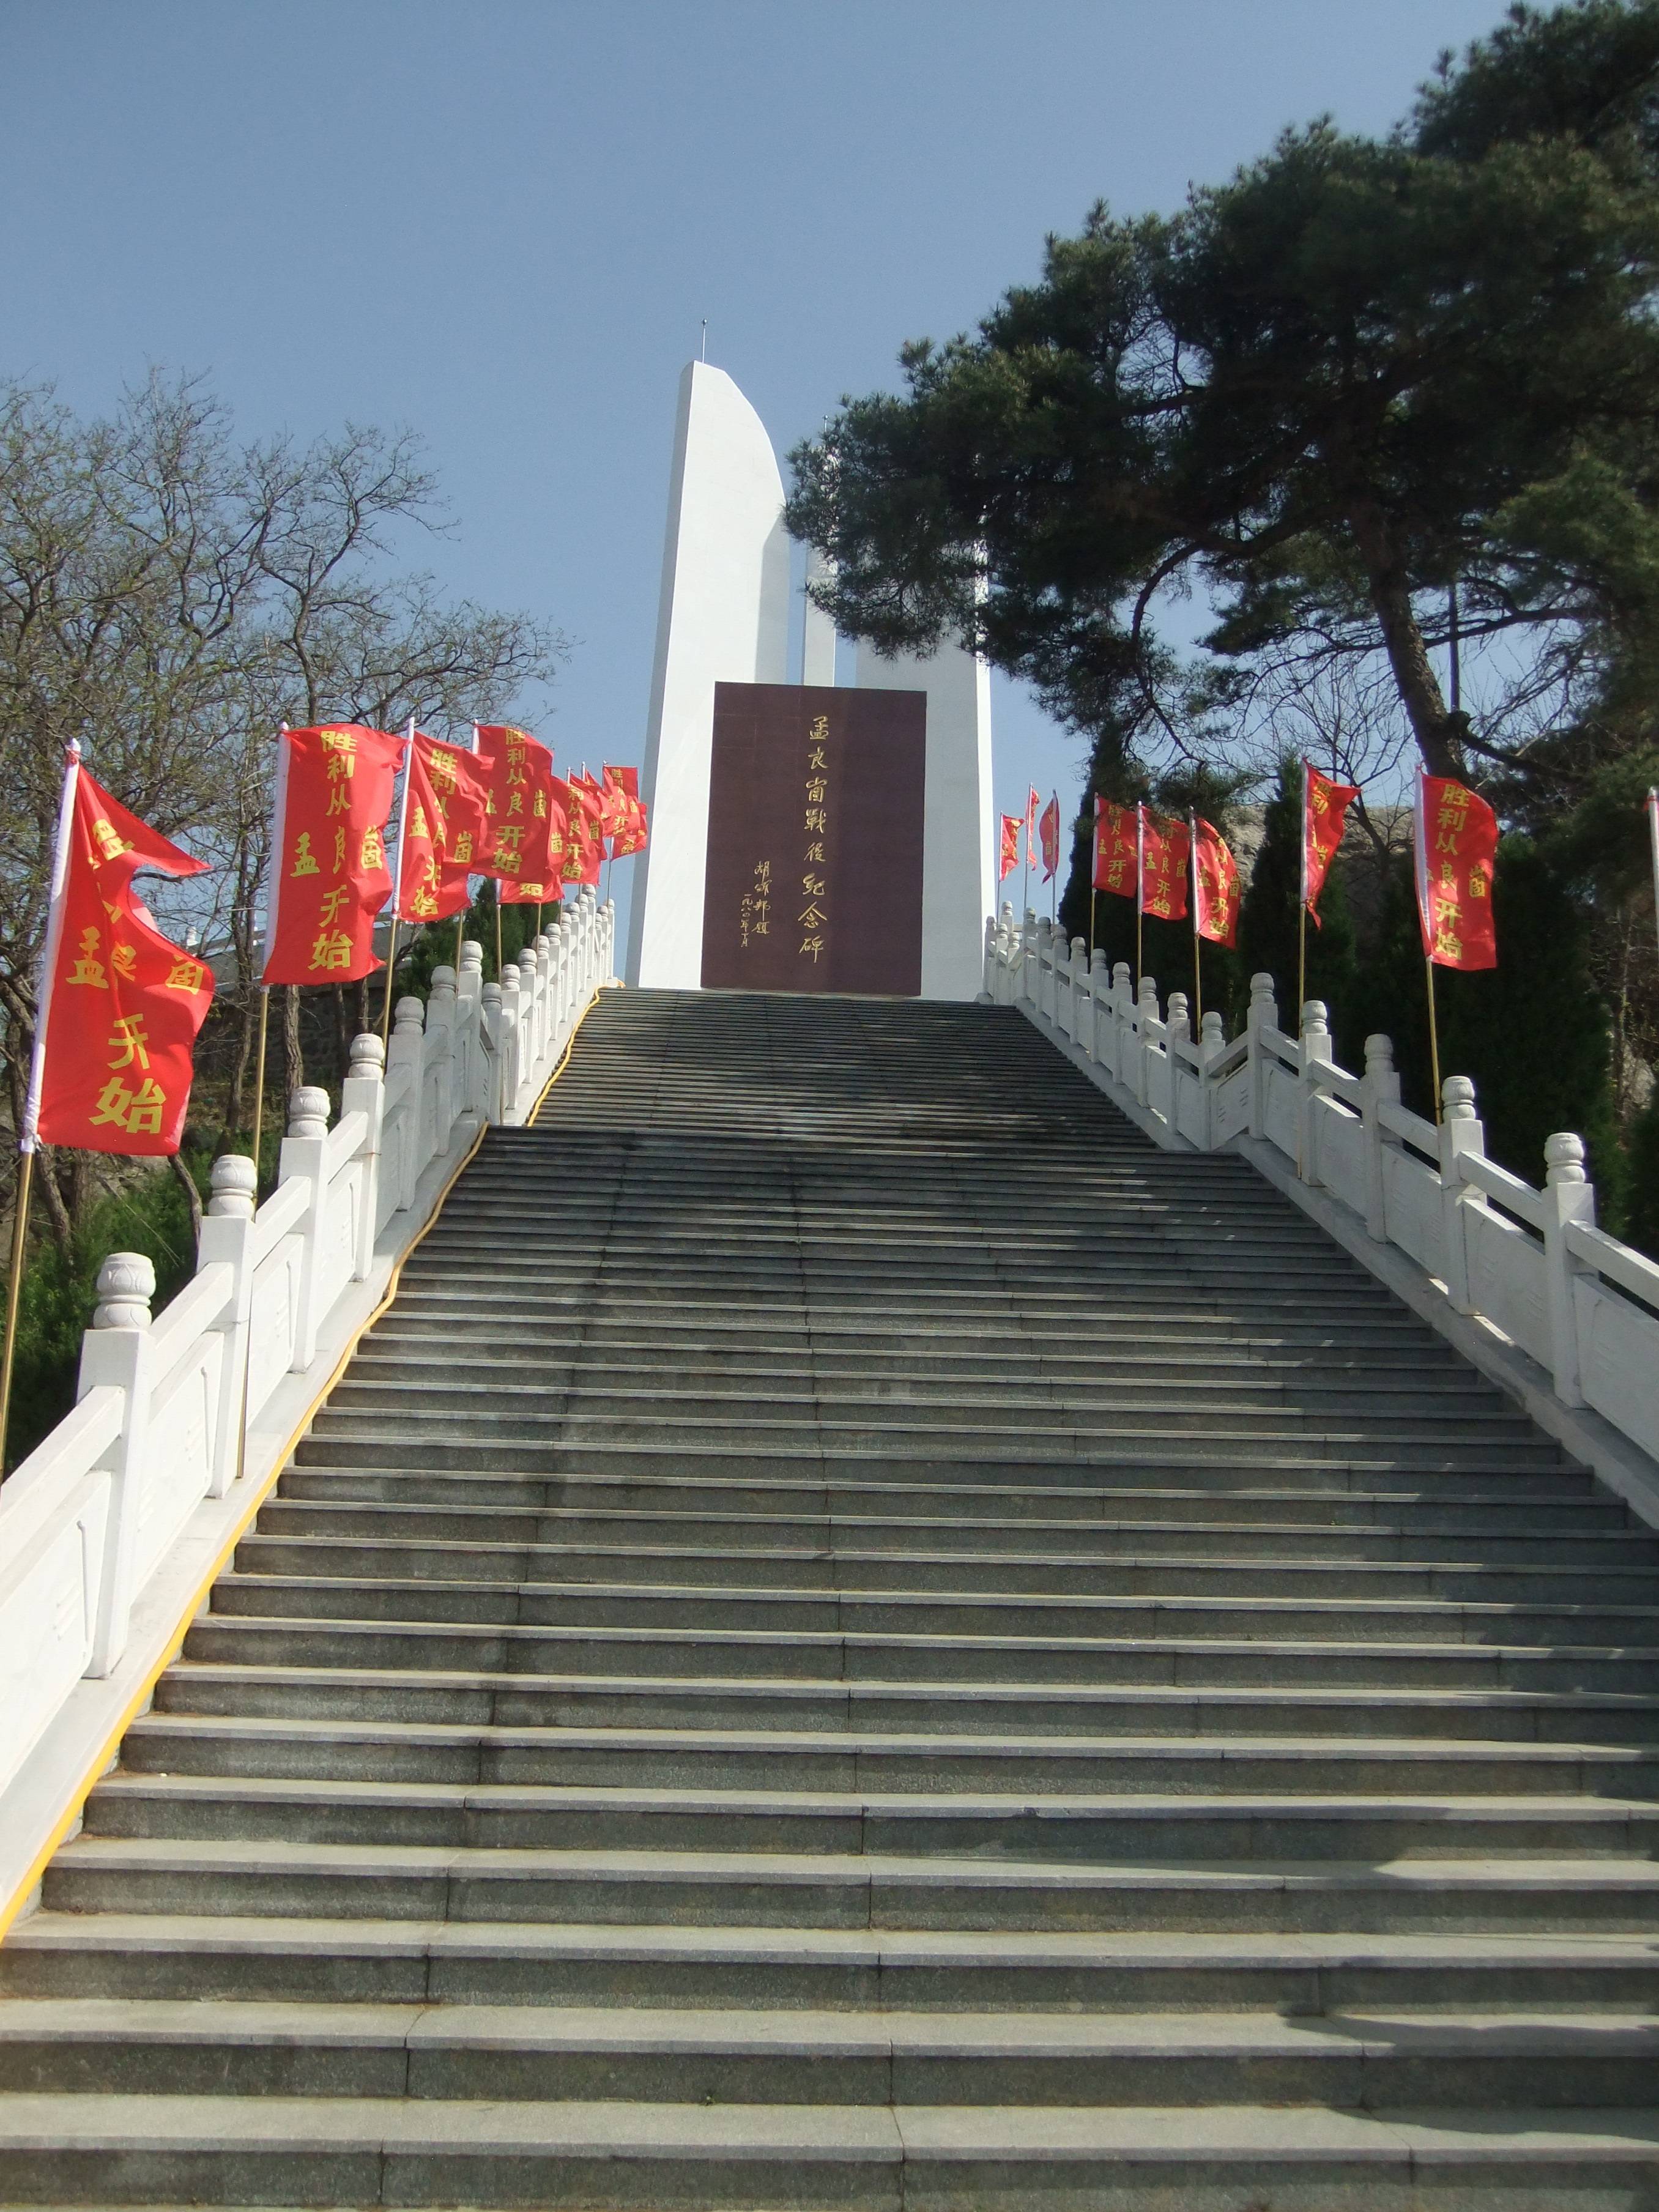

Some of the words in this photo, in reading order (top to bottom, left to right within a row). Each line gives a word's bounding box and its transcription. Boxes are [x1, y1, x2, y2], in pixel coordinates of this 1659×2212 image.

[320, 730, 358, 817] 胜利从
[506, 728, 527, 785] 胜利从
[1435, 784, 1469, 856] 胜利从
[290, 824, 383, 878] 孟良崮
[491, 825, 526, 874] 开始
[562, 843, 584, 880] 开始
[1107, 859, 1127, 889] 开始
[1145, 852, 1186, 877] 孟良崮
[1152, 878, 1171, 915] 开始
[1208, 896, 1230, 939] 开始
[308, 884, 354, 971] 开始
[1434, 897, 1463, 960] 开始
[65, 925, 205, 996] 孟良崮
[89, 1012, 167, 1135] 开始
